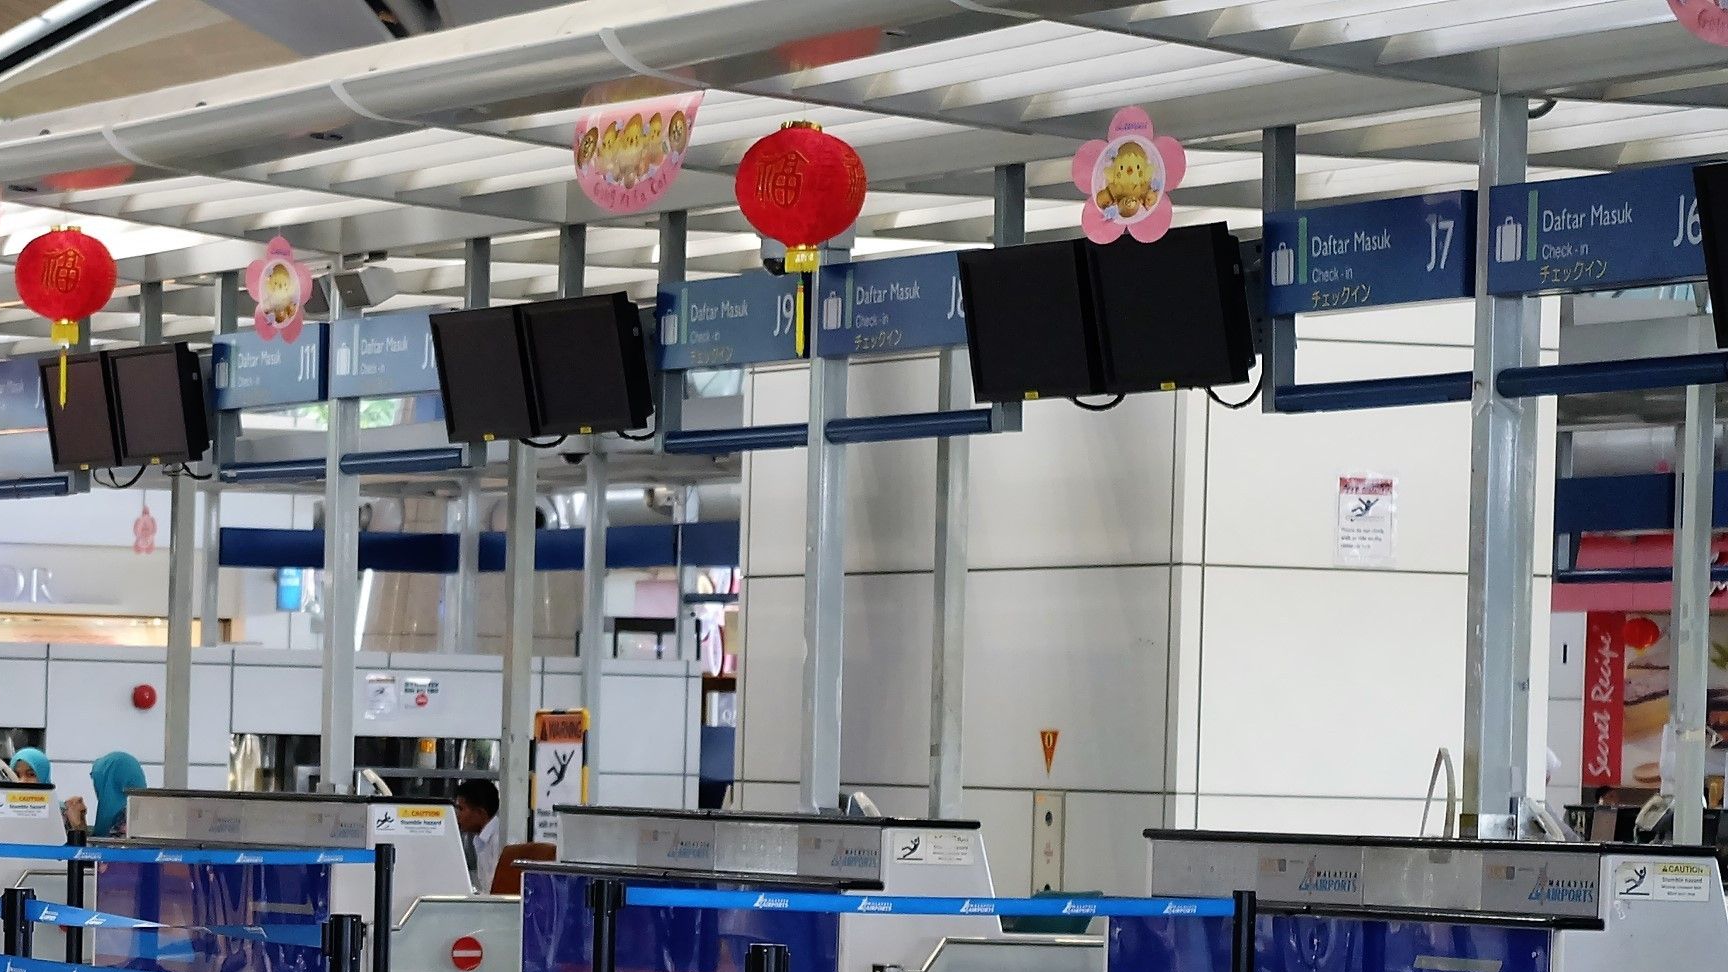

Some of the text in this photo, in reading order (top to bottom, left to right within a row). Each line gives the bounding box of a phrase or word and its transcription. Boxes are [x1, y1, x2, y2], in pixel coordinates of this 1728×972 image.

[1542, 202, 1633, 233] Daftar Masuk
[1311, 228, 1391, 258] Daftar Masuk
[1426, 218, 1455, 273] J7
[855, 281, 921, 305] Daftar Masuk
[690, 300, 749, 322] Daftar Masuk
[773, 293, 795, 336] J9
[297, 344, 316, 382] J11
[1588, 632, 1619, 778] Secret Recipe
[1316, 871, 1357, 879] MALAYSIA
[1668, 865, 1703, 874] CAUTION
[1311, 879, 1357, 894] AIRPORTS
[1544, 887, 1593, 902] AIRPORTS
[1548, 879, 1594, 888] MALAYSIA
